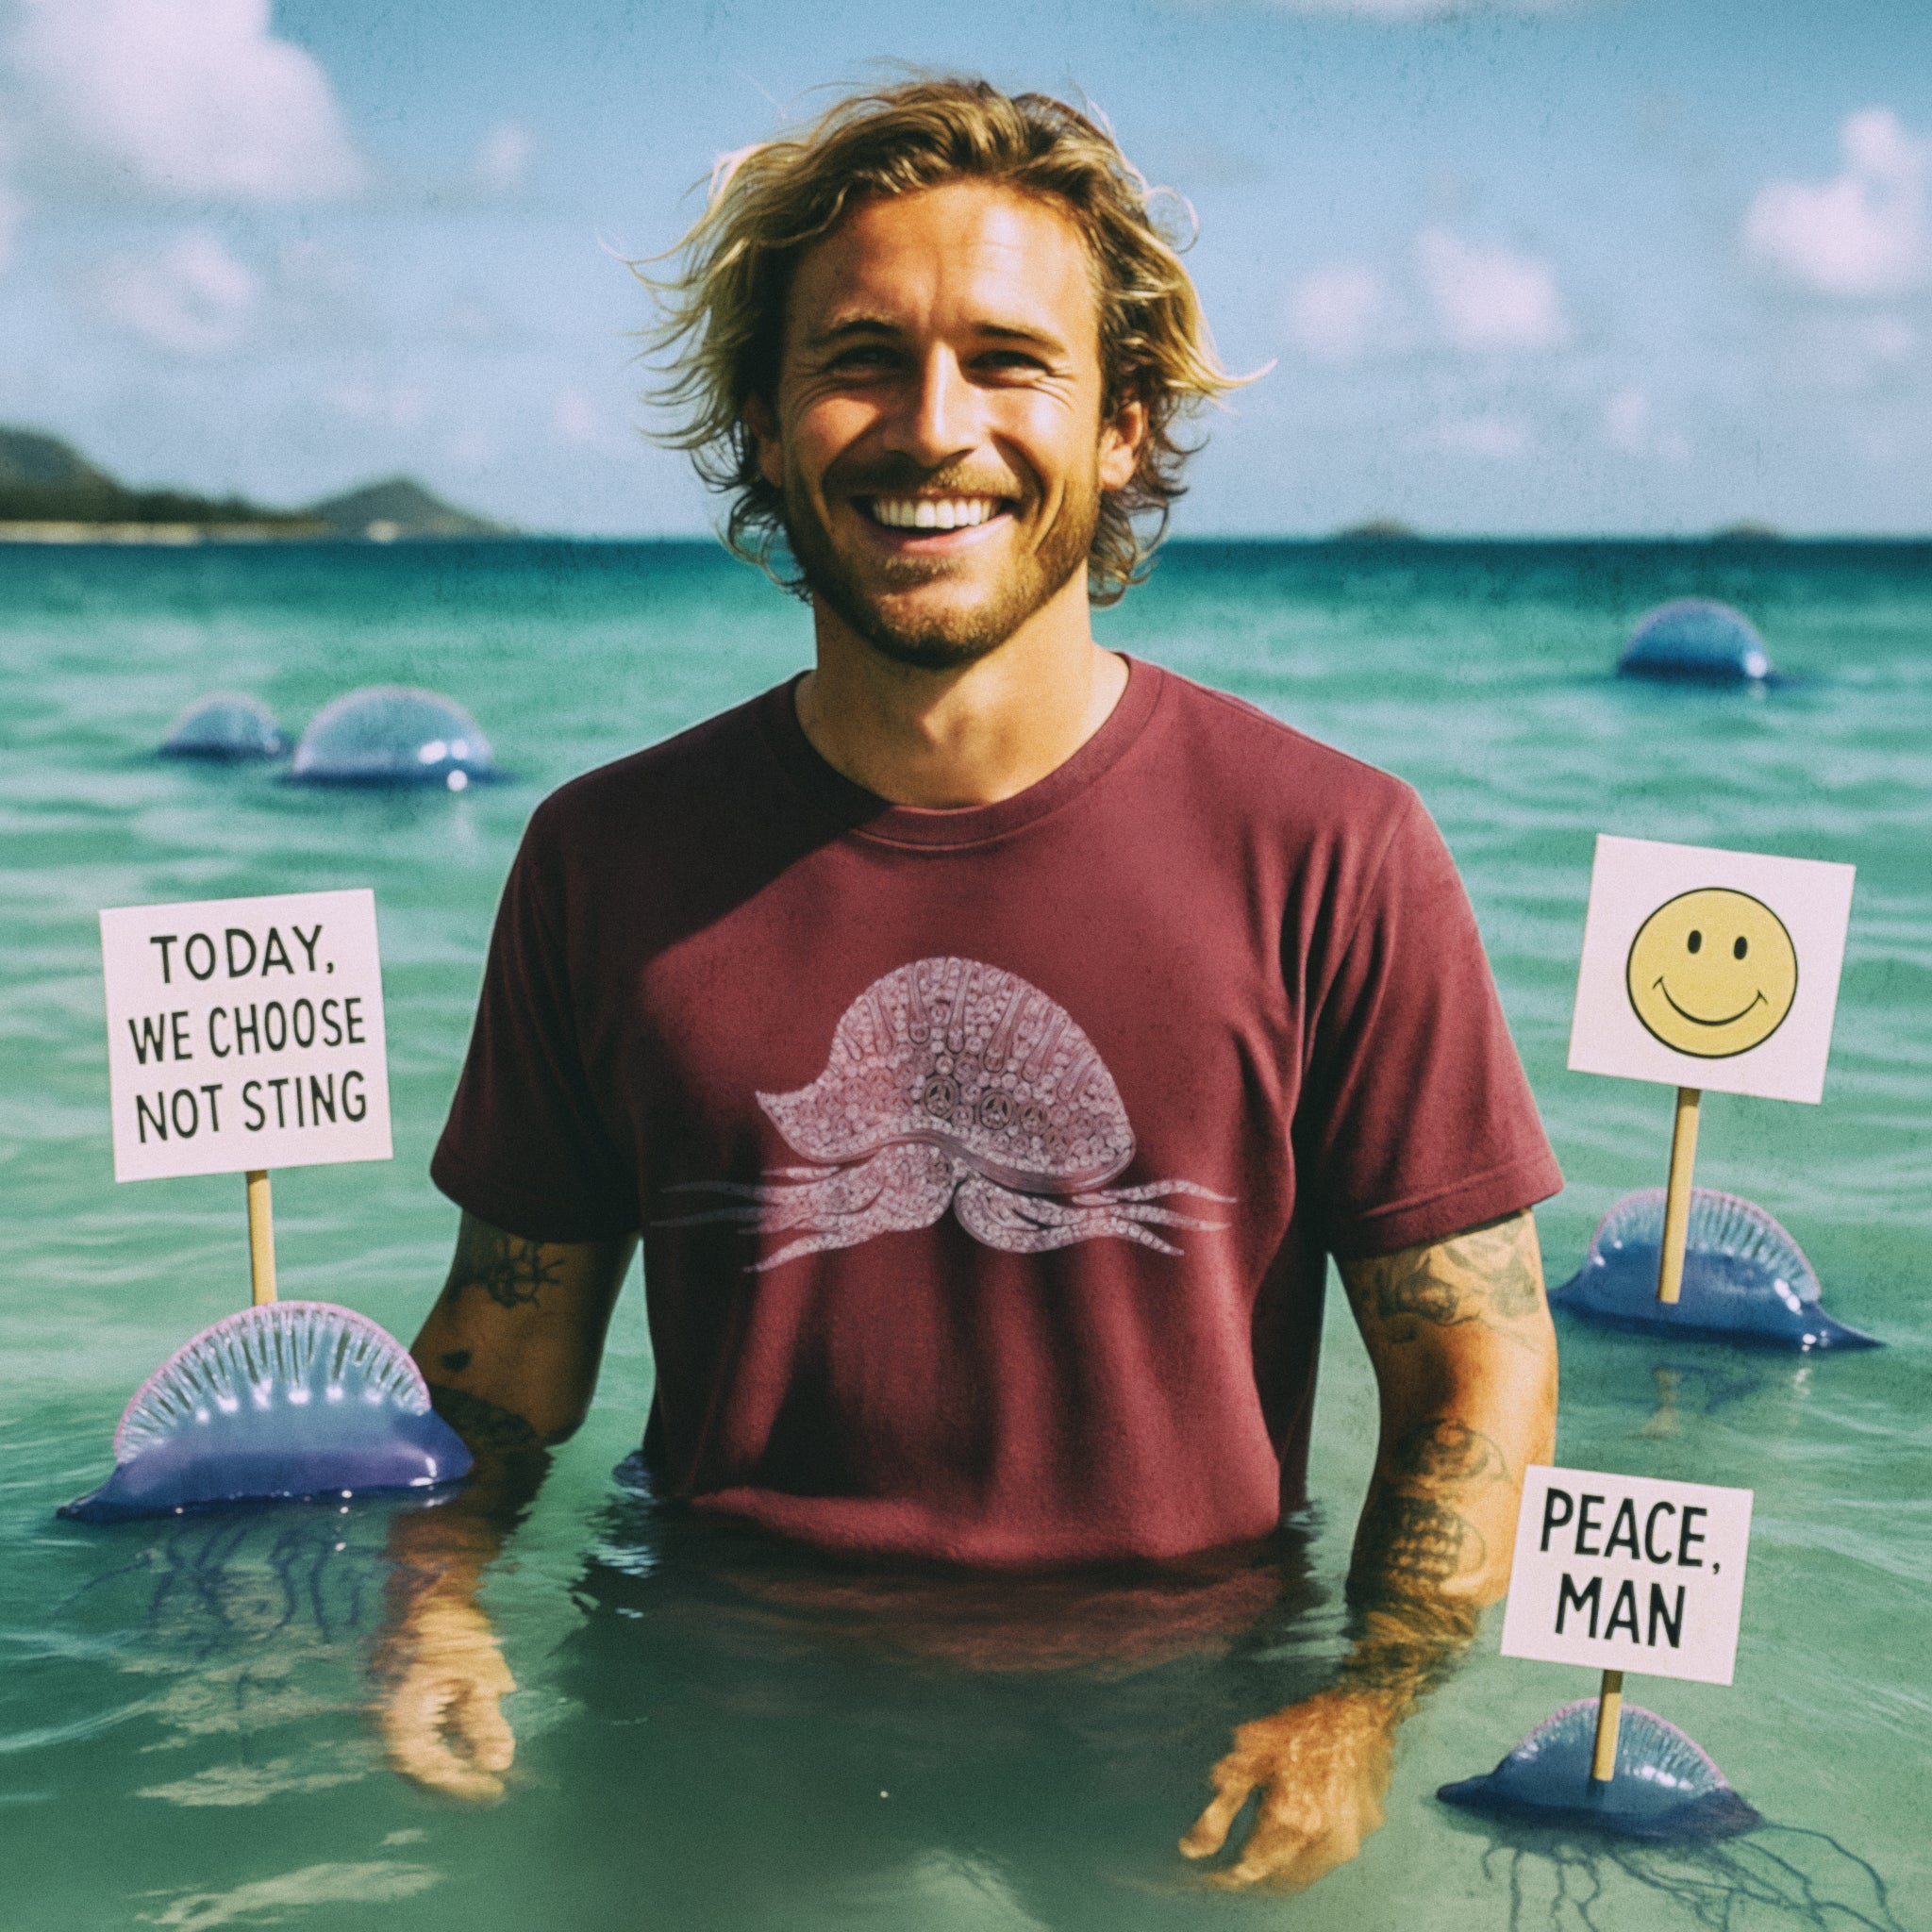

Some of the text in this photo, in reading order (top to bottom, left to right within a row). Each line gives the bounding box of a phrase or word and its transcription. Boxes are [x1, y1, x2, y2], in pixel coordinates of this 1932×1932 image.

[150, 924, 334, 984] TODAY,
[128, 997, 366, 1065] WE CHOOSE
[136, 1070, 367, 1143] NOT STING
[1540, 1487, 1721, 1574] PEACE,
[1555, 1573, 1686, 1649] MAN
